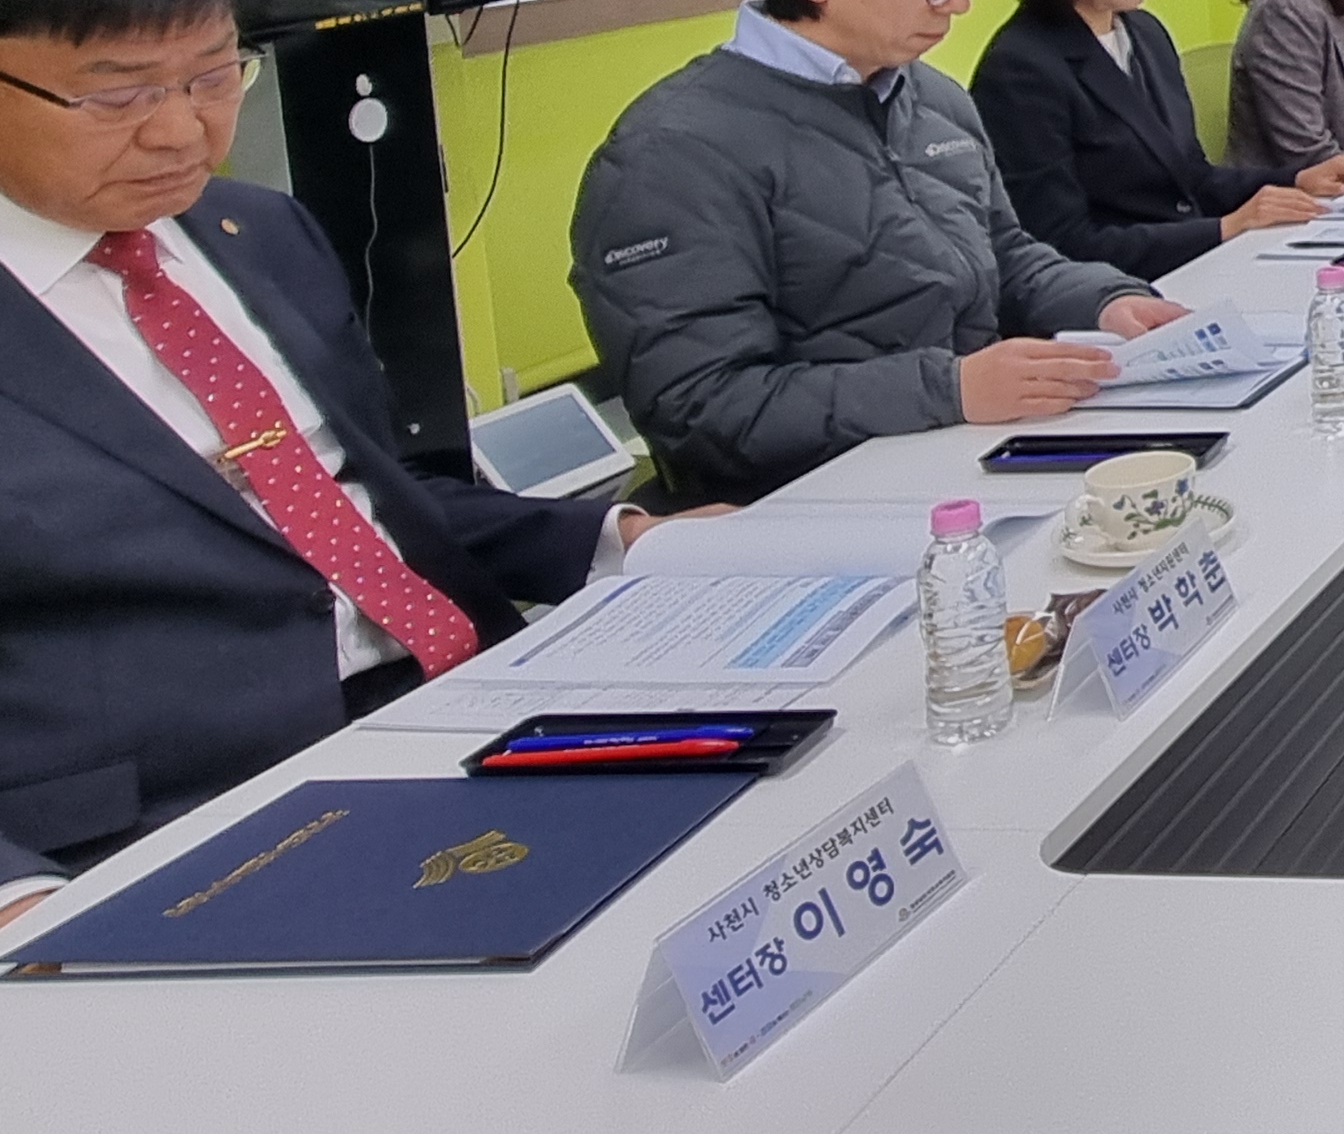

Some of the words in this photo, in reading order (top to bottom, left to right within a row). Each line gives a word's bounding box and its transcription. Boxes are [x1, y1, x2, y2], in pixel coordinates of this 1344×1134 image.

[1106, 623, 1151, 678] 센터장
[1147, 549, 1227, 633] 박학춘
[1112, 586, 1140, 615] 사천시
[699, 935, 789, 1026] 센터장
[792, 816, 945, 942] 이영숙
[706, 896, 761, 944] 사천시
[762, 796, 896, 903] 청소년상담복지센터
